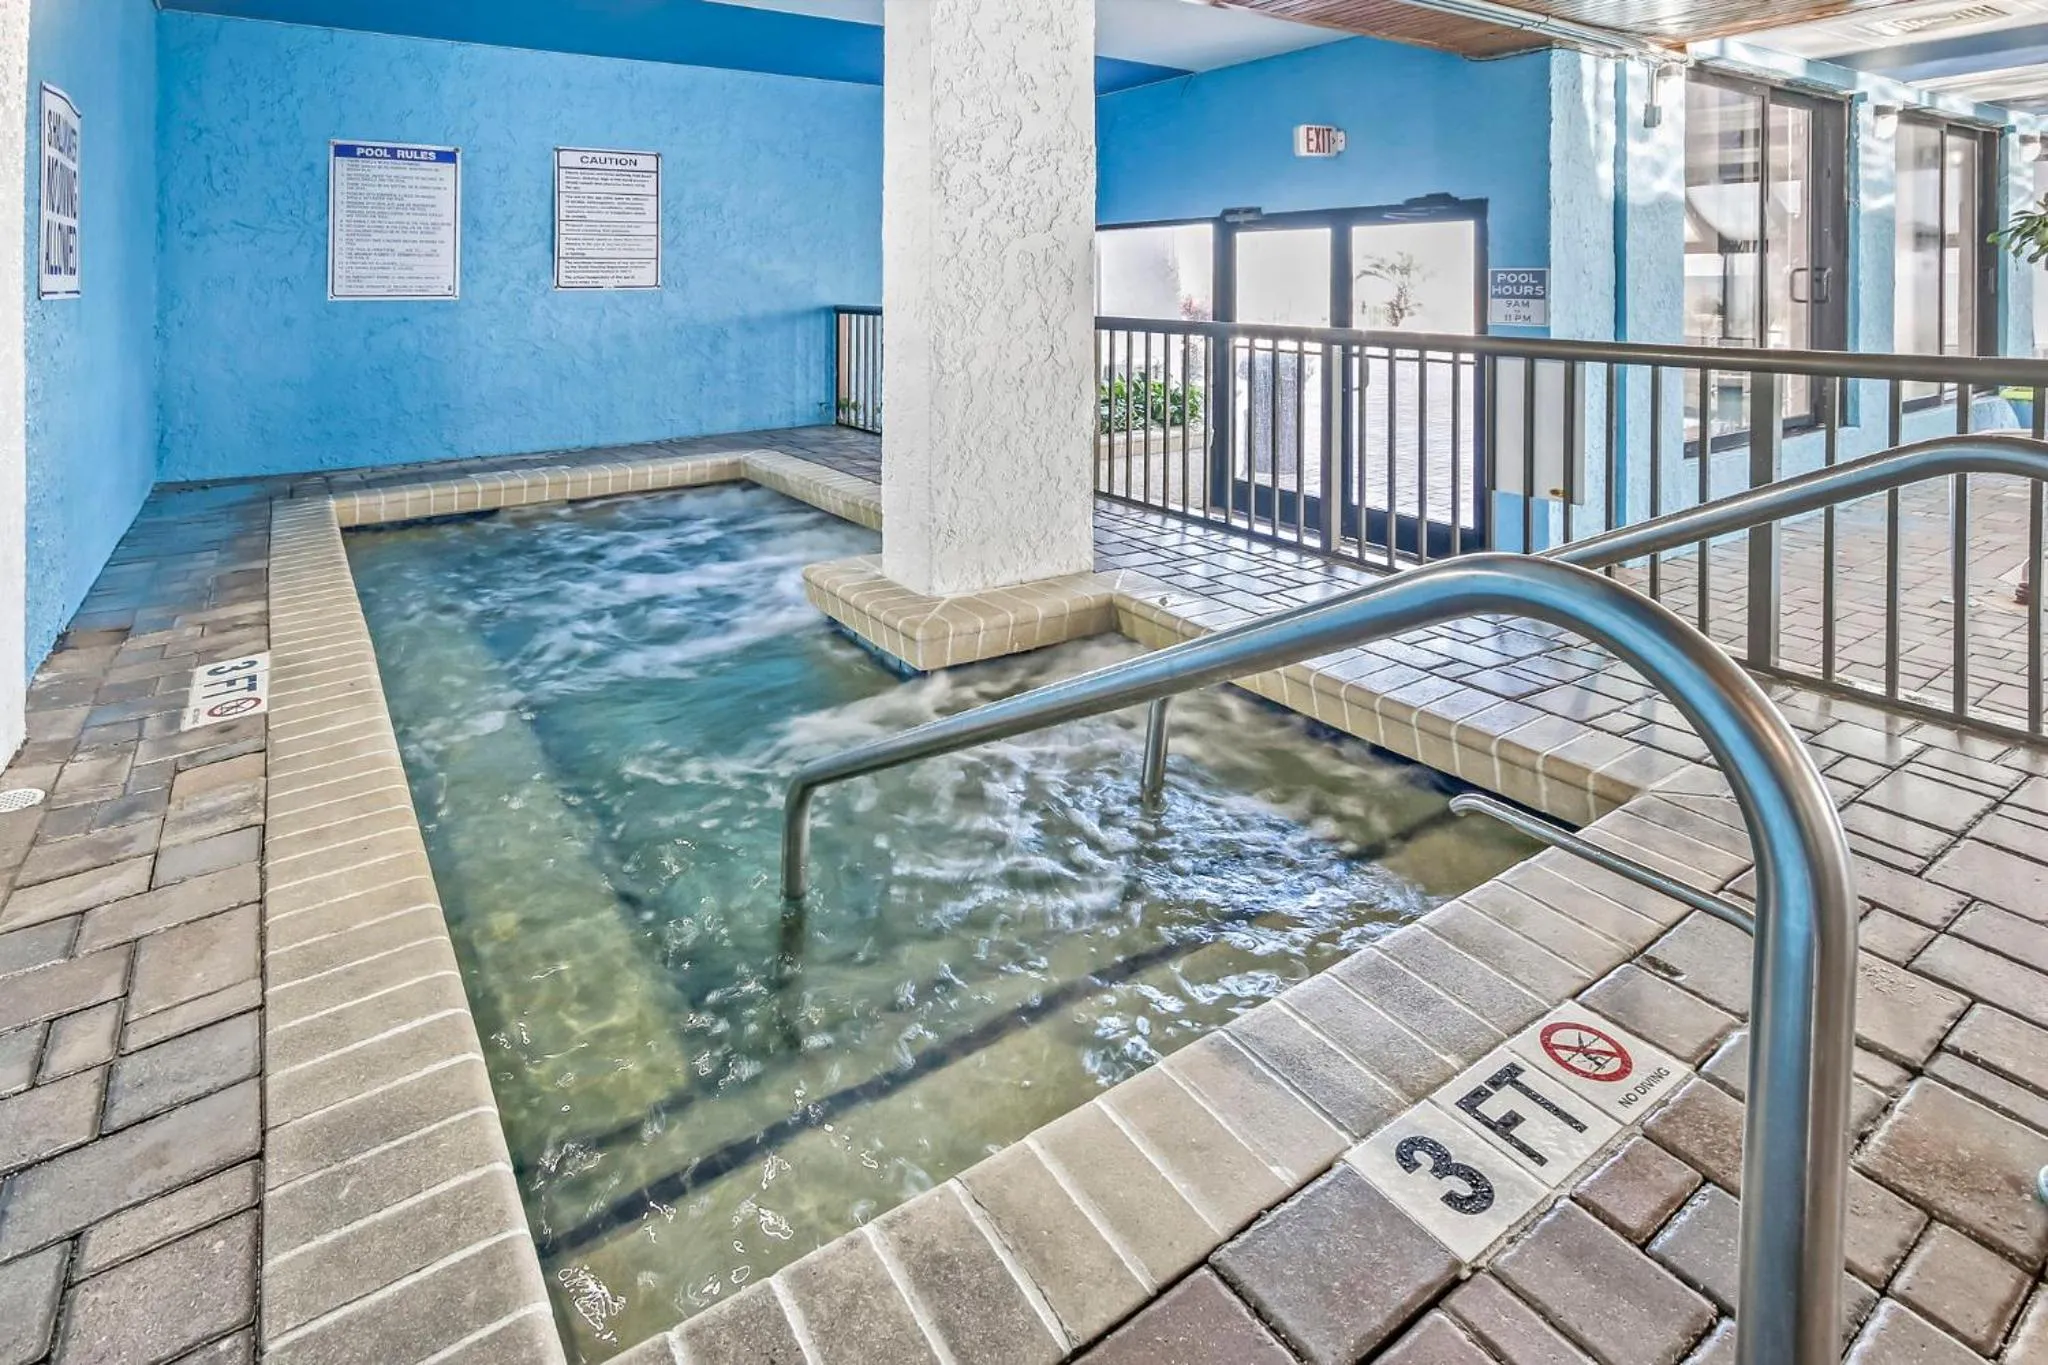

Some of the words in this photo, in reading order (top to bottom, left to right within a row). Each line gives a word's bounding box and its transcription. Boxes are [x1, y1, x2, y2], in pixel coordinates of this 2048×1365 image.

[1306, 127, 1332, 153] EXIT
[356, 147, 391, 159] POOL
[396, 149, 436, 161] RULES
[579, 155, 638, 167] CAUTION
[1497, 273, 1538, 283] POOL
[1491, 285, 1544, 296] HOURS
[207, 660, 258, 676] 3
[201, 674, 258, 699] FT
[1618, 1092, 1639, 1109] NO
[1633, 1066, 1671, 1095] DIVING
[1394, 1135, 1496, 1216] 3
[1454, 1061, 1589, 1168] FT
